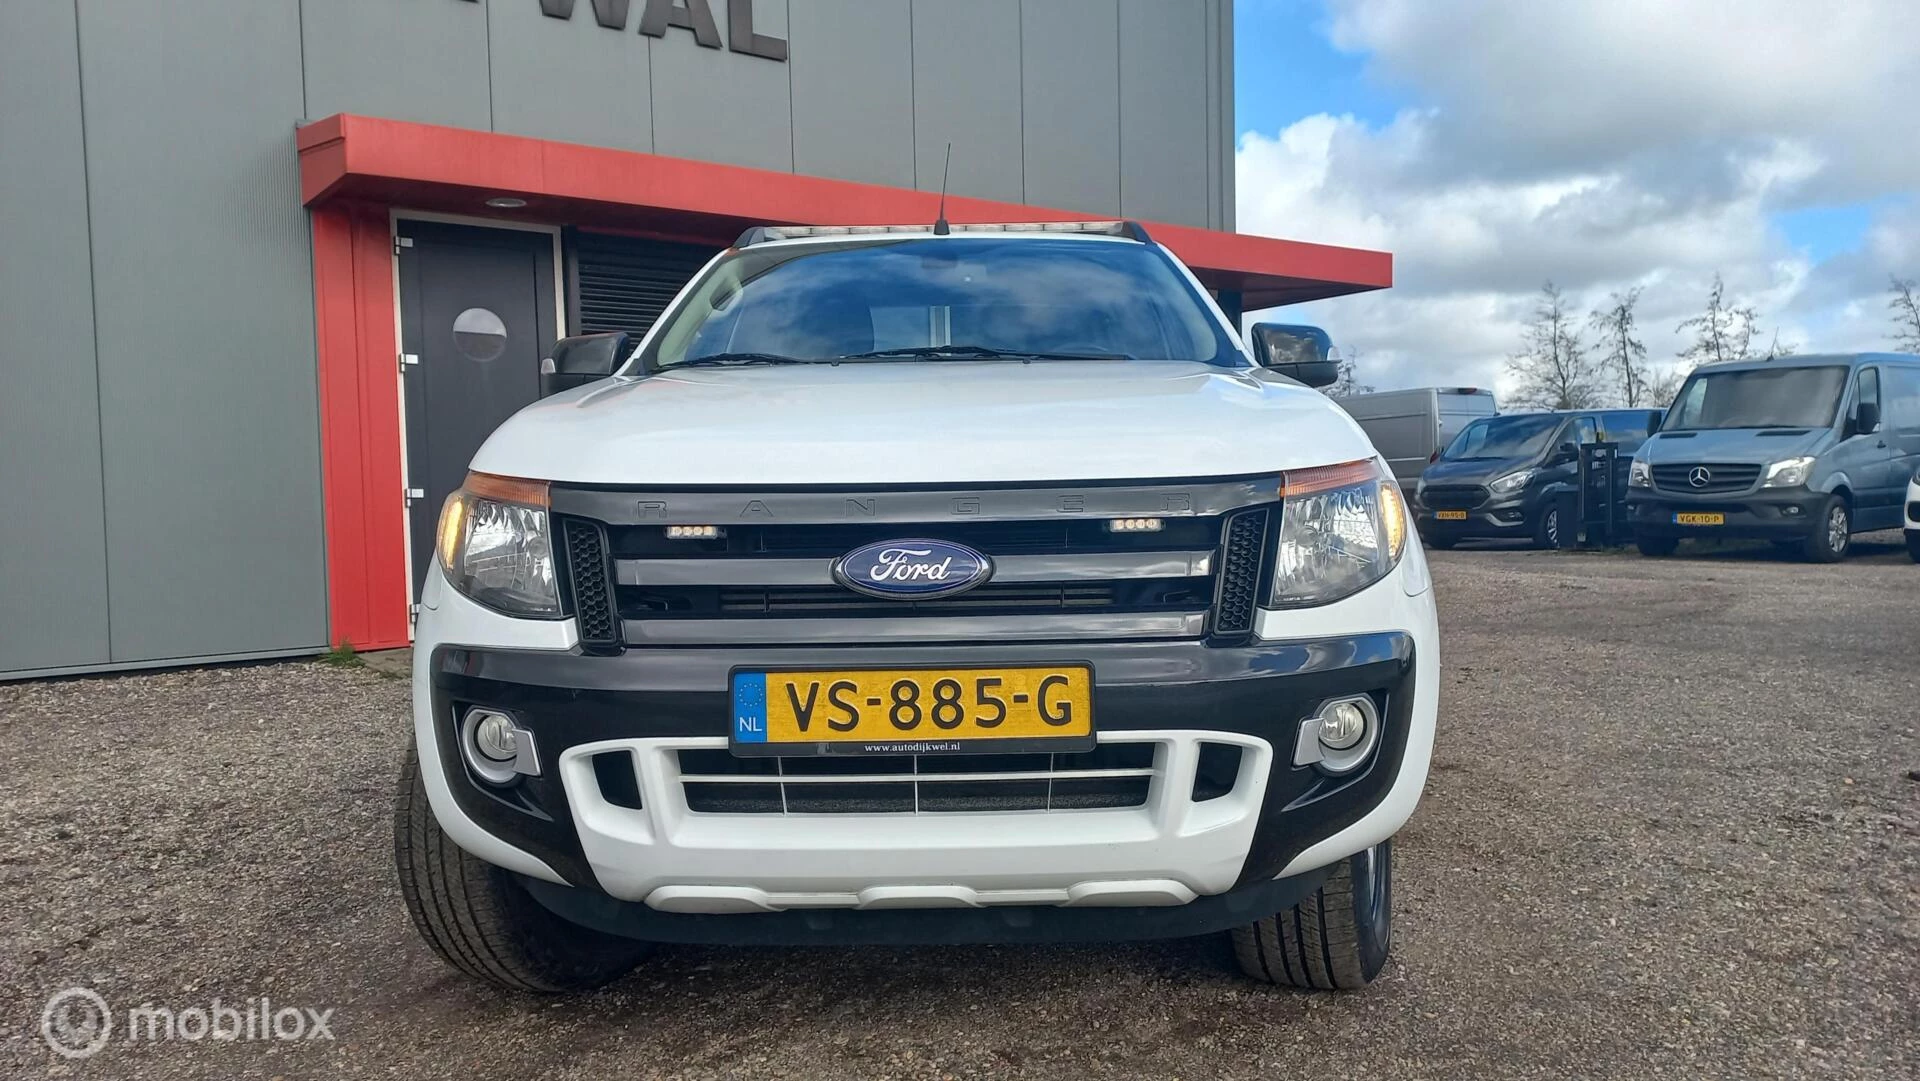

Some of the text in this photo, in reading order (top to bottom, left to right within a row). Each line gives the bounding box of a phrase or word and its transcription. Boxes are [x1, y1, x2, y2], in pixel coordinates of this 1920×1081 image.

[636, 492, 1191, 519] RANGER
[870, 548, 952, 580] Ford
[786, 675, 1072, 732] VS-885-G
[738, 717, 762, 732] NL
[864, 742, 961, 753] www.autodijkwel.nl
